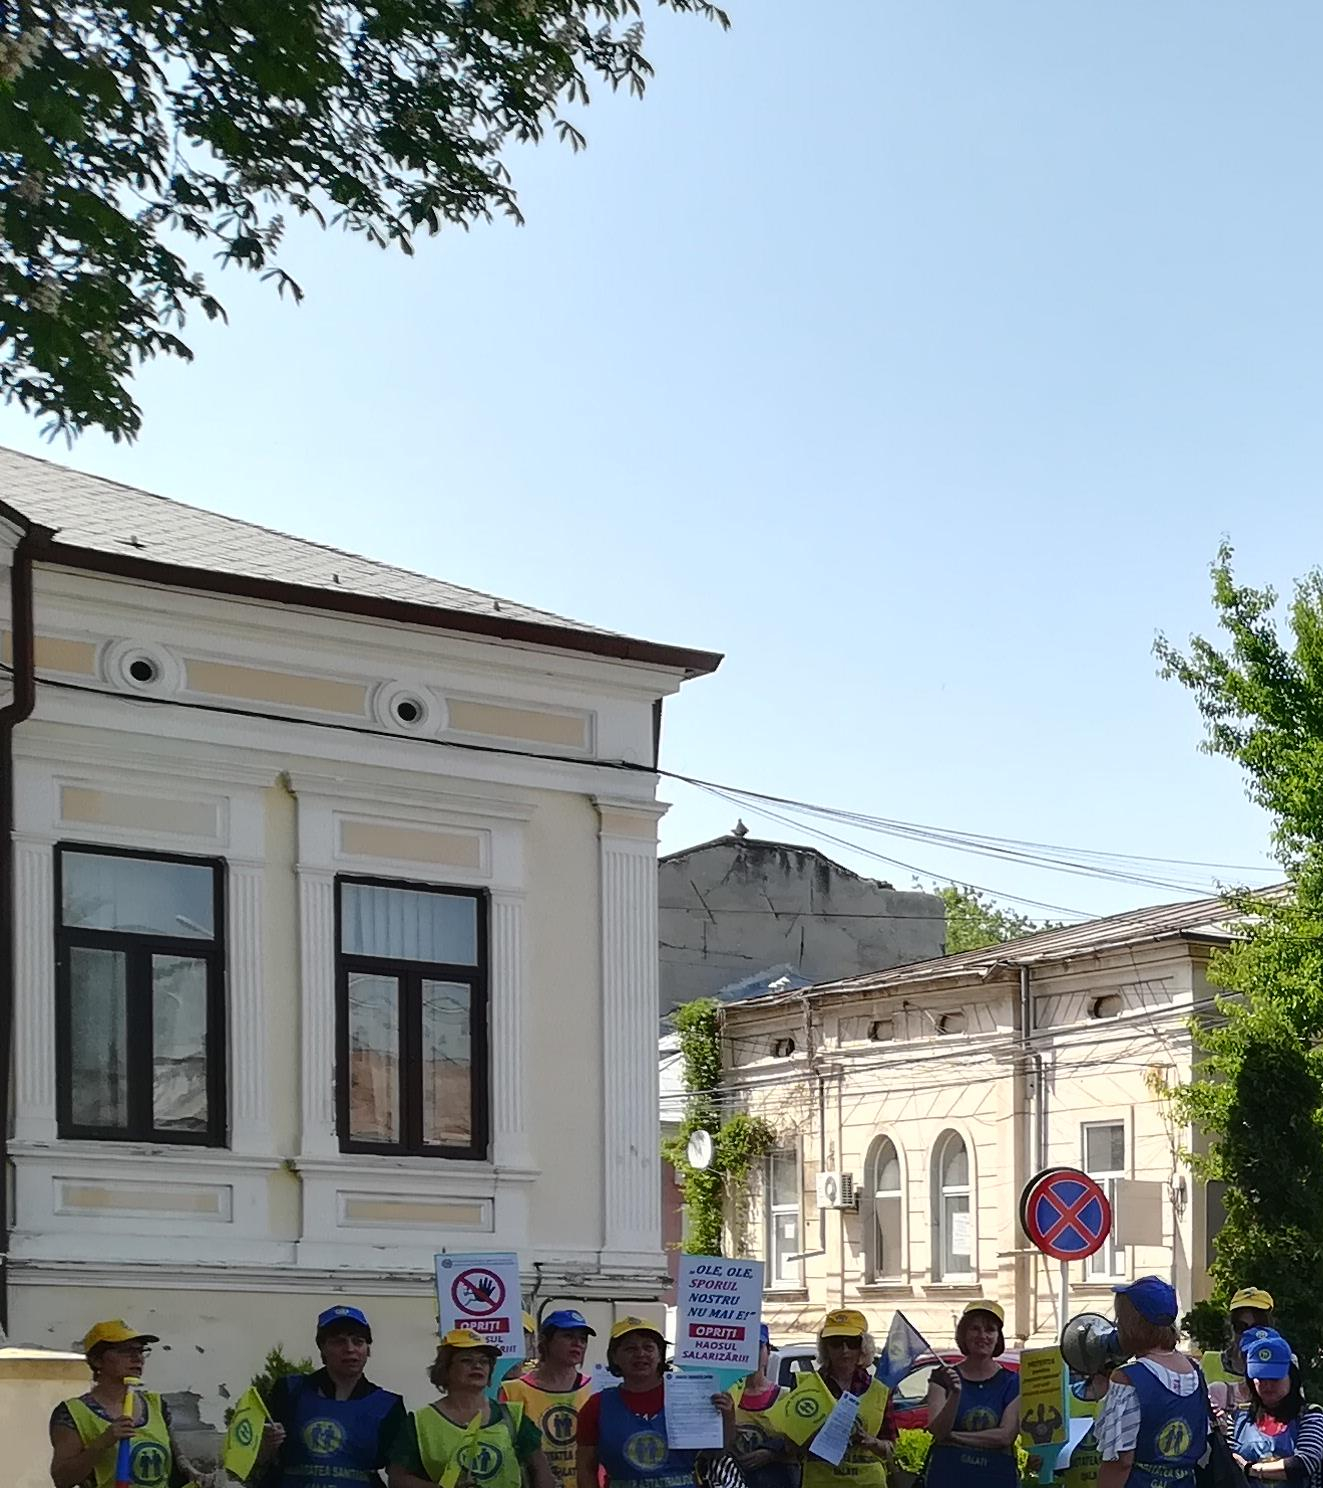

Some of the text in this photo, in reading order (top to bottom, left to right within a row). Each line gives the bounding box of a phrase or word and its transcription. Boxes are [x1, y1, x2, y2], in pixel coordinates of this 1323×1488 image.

[688, 1279, 738, 1292] SPORUL
[688, 1293, 740, 1305] NOSTRU
[688, 1307, 708, 1317] NU
[708, 1309, 734, 1319] MAI
[696, 1326, 737, 1339] OPRIȚI
[486, 1335, 504, 1344] SUL
[695, 1341, 737, 1351] HAOSUL
